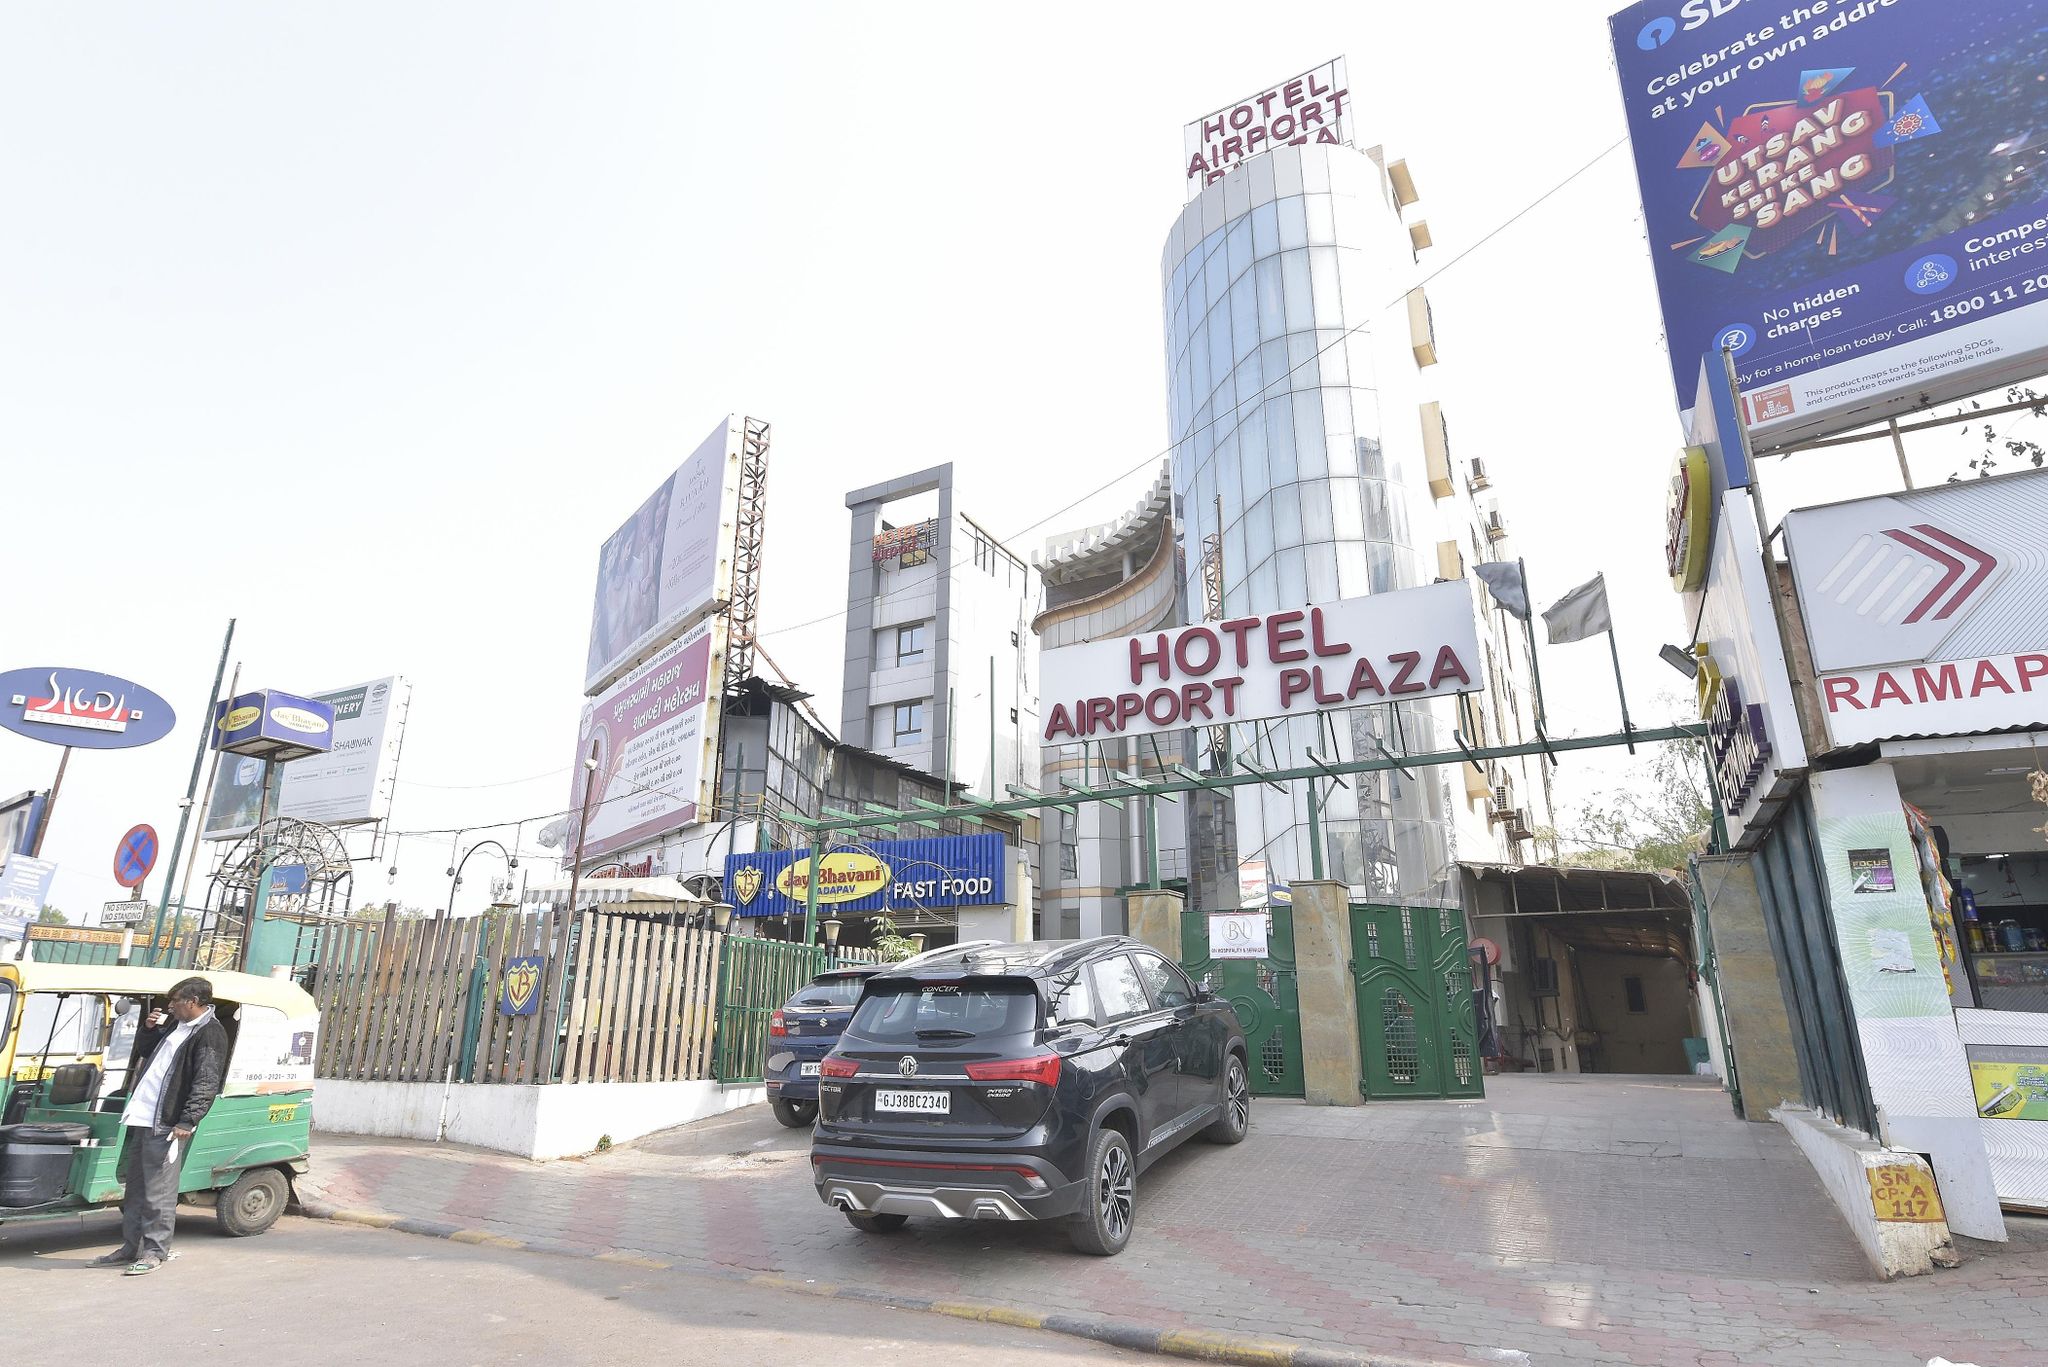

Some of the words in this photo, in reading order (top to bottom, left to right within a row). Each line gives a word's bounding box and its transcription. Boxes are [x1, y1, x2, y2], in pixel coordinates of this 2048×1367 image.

[1647, 25, 1775, 96] Celebrate
[1779, 1, 1829, 31] the
[1651, 96, 1678, 119] at
[1681, 63, 1743, 108] your
[1747, 35, 1807, 71] own
[1187, 88, 1348, 179] AIRPORT
[1203, 74, 1330, 143] HOTEL
[1716, 98, 1843, 185] UTSAV
[1721, 180, 1754, 208] KE
[1757, 111, 1868, 187] RANG
[1733, 186, 1775, 219] SBI
[1780, 164, 1815, 193] KE
[1756, 154, 1868, 228] SANG
[1964, 214, 2048, 253] Compe
[1968, 236, 2048, 271] interes
[1763, 307, 1790, 324] No
[1793, 283, 1860, 314] hidden
[1767, 306, 1843, 339] charges
[1754, 367, 1773, 379] for
[1775, 364, 1783, 373] a
[1783, 353, 1822, 370] home
[1823, 343, 1852, 358] loan
[1853, 329, 1896, 348] today.
[1897, 317, 1928, 335] Call:
[1930, 296, 1985, 324] 1800
[1989, 285, 2018, 304] 11
[1805, 387, 1824, 398] This
[1825, 377, 1861, 396] product
[1862, 369, 1888, 384] maps
[1888, 365, 1900, 375] to
[1901, 359, 1918, 370] the
[1918, 347, 1964, 366] following
[1964, 338, 1995, 352] SDGs
[1806, 396, 1823, 407] and
[1823, 382, 1876, 402] contributes
[1877, 371, 1917, 386] towards
[1917, 355, 1974, 376] Sustainable
[1129, 607, 1352, 686] HOTEL
[34, 671, 125, 720] SIGDI
[1044, 676, 1244, 741] AIRPORT
[1279, 644, 1471, 710] PLAZA
[817, 865, 882, 885] Bhavani
[817, 884, 856, 896] ADAPAV
[893, 880, 937, 900] FAST
[941, 877, 993, 897] FOOD
[114, 911, 142, 920] STANDING
[115, 903, 143, 911] STOPPING
[883, 1094, 948, 1109] GJ38BC2340
[1891, 1200, 1929, 1217] 117
